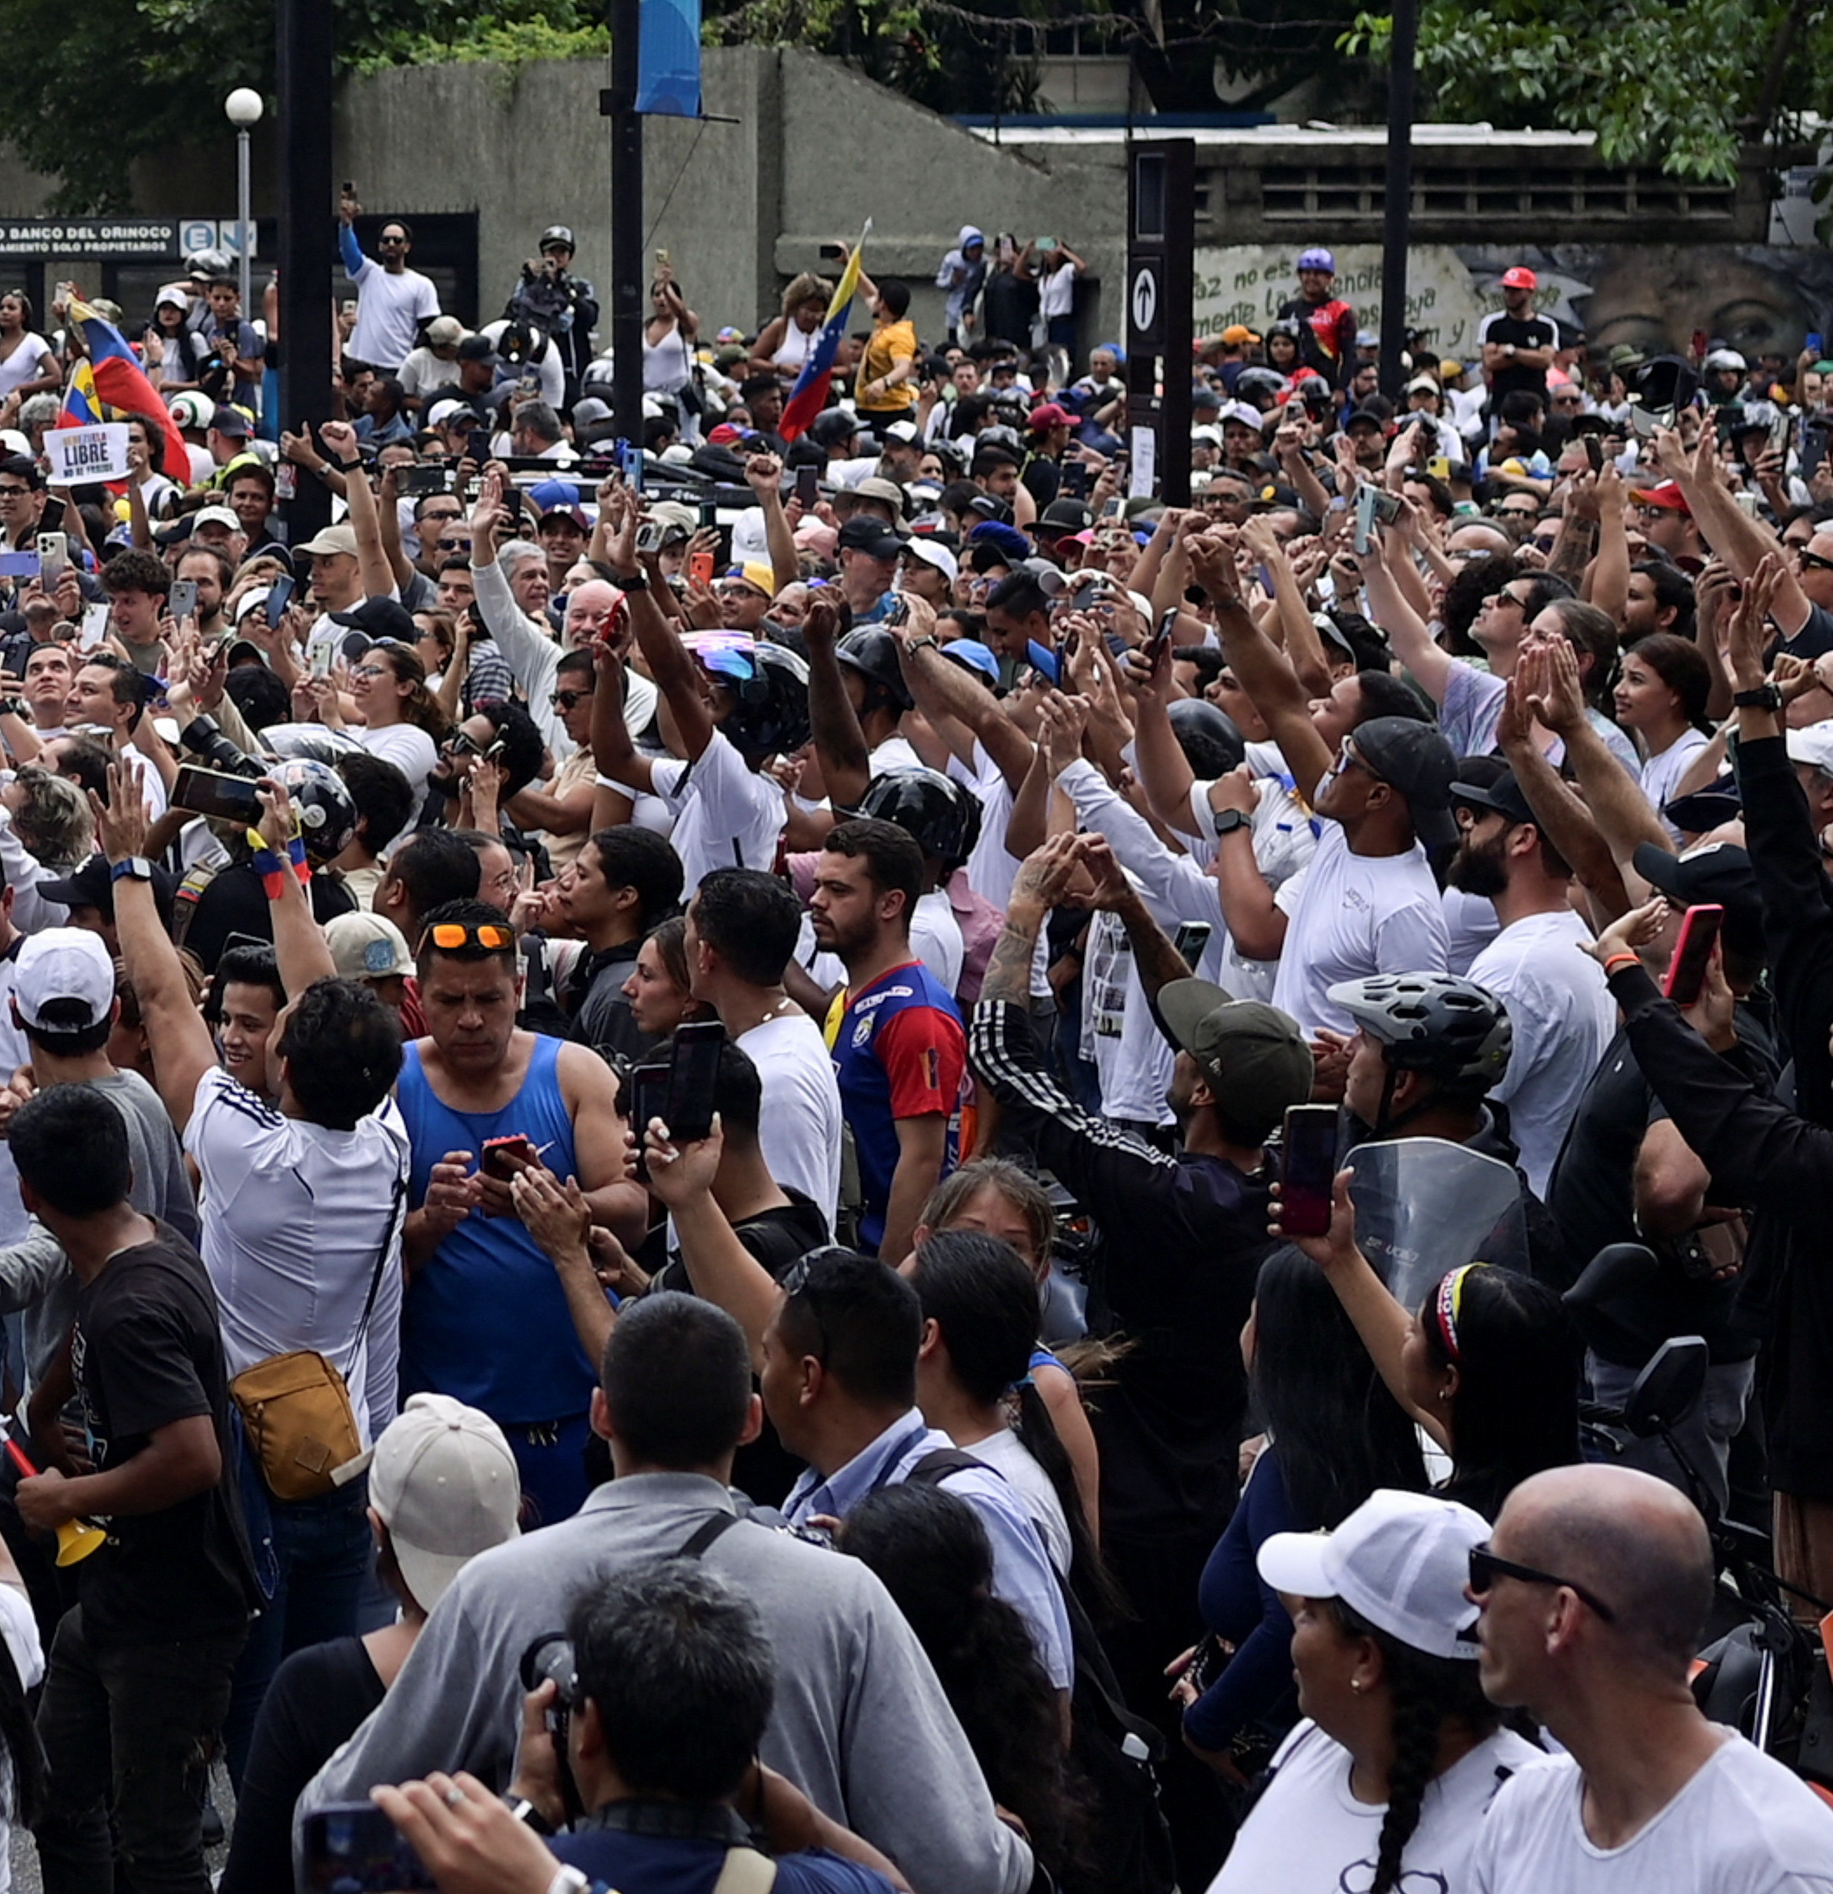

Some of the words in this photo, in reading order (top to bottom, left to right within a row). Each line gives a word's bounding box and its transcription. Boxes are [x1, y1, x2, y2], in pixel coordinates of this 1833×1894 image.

[10, 227, 63, 240] BANCO
[67, 227, 96, 239] DEL
[101, 226, 171, 240] ORINOCO
[52, 242, 81, 252] SOLO
[84, 242, 167, 252] PROPIETARIOS
[1194, 273, 1221, 300] az
[1234, 269, 1258, 290] no
[1264, 261, 1291, 281] es
[64, 442, 109, 467] LIBRE
